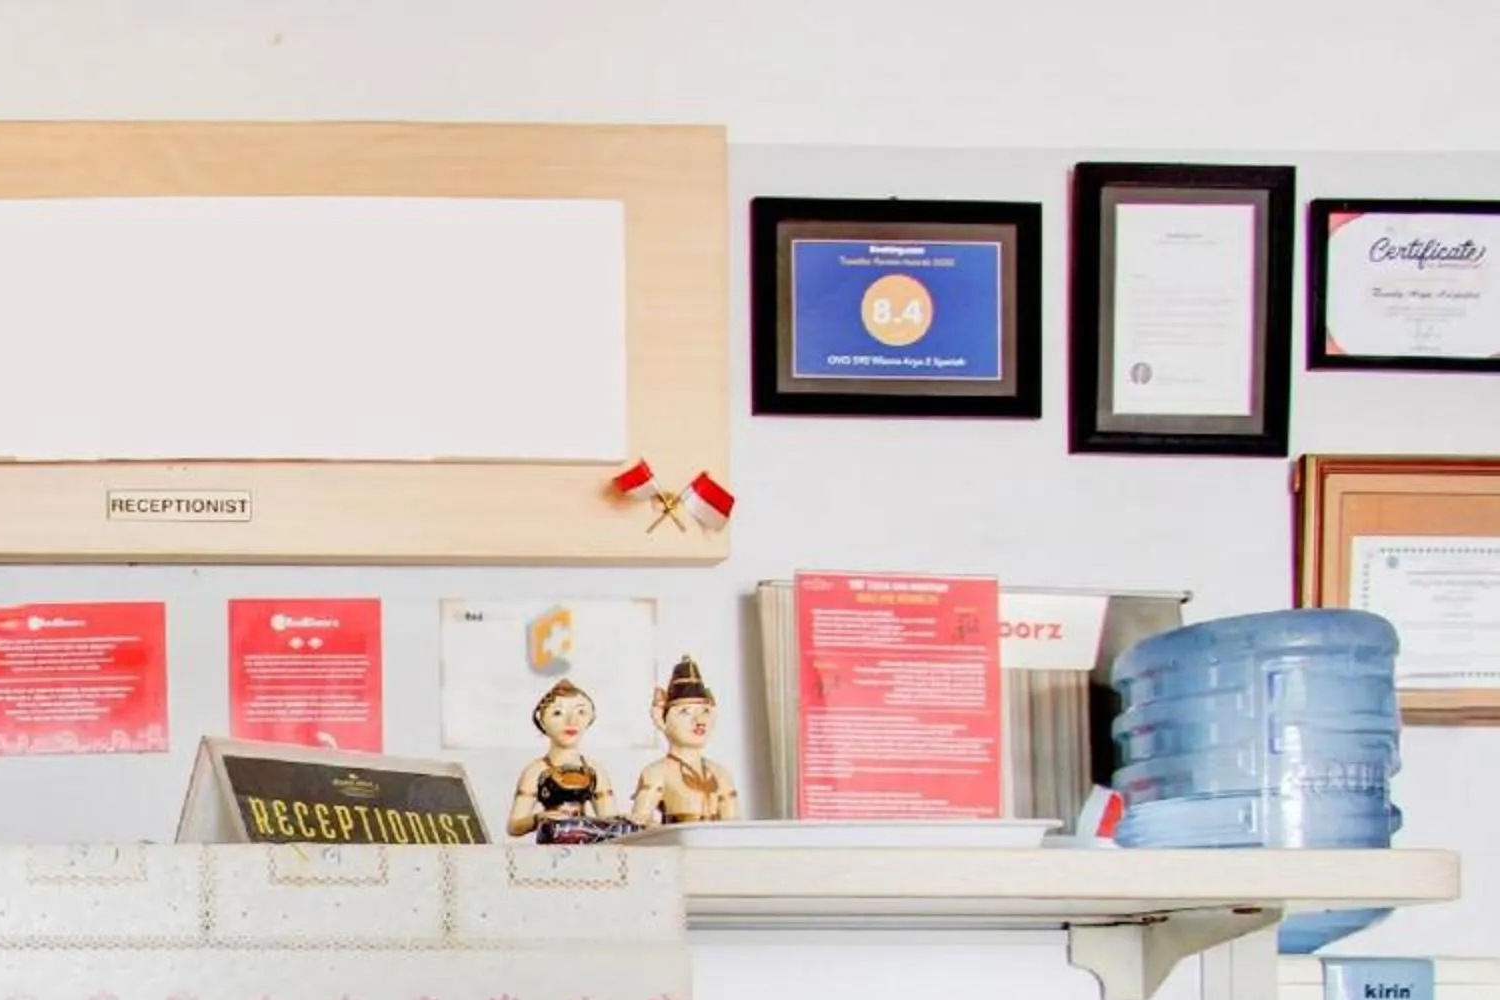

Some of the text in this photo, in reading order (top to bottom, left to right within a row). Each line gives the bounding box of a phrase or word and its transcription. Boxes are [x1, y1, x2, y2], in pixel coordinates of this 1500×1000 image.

[1369, 236, 1486, 271] Certificate
[872, 297, 924, 325] 8.4
[110, 498, 247, 514] RECEPTIONIST
[248, 796, 475, 844] RECEPTIONIST
[1364, 983, 1411, 999] kirin
